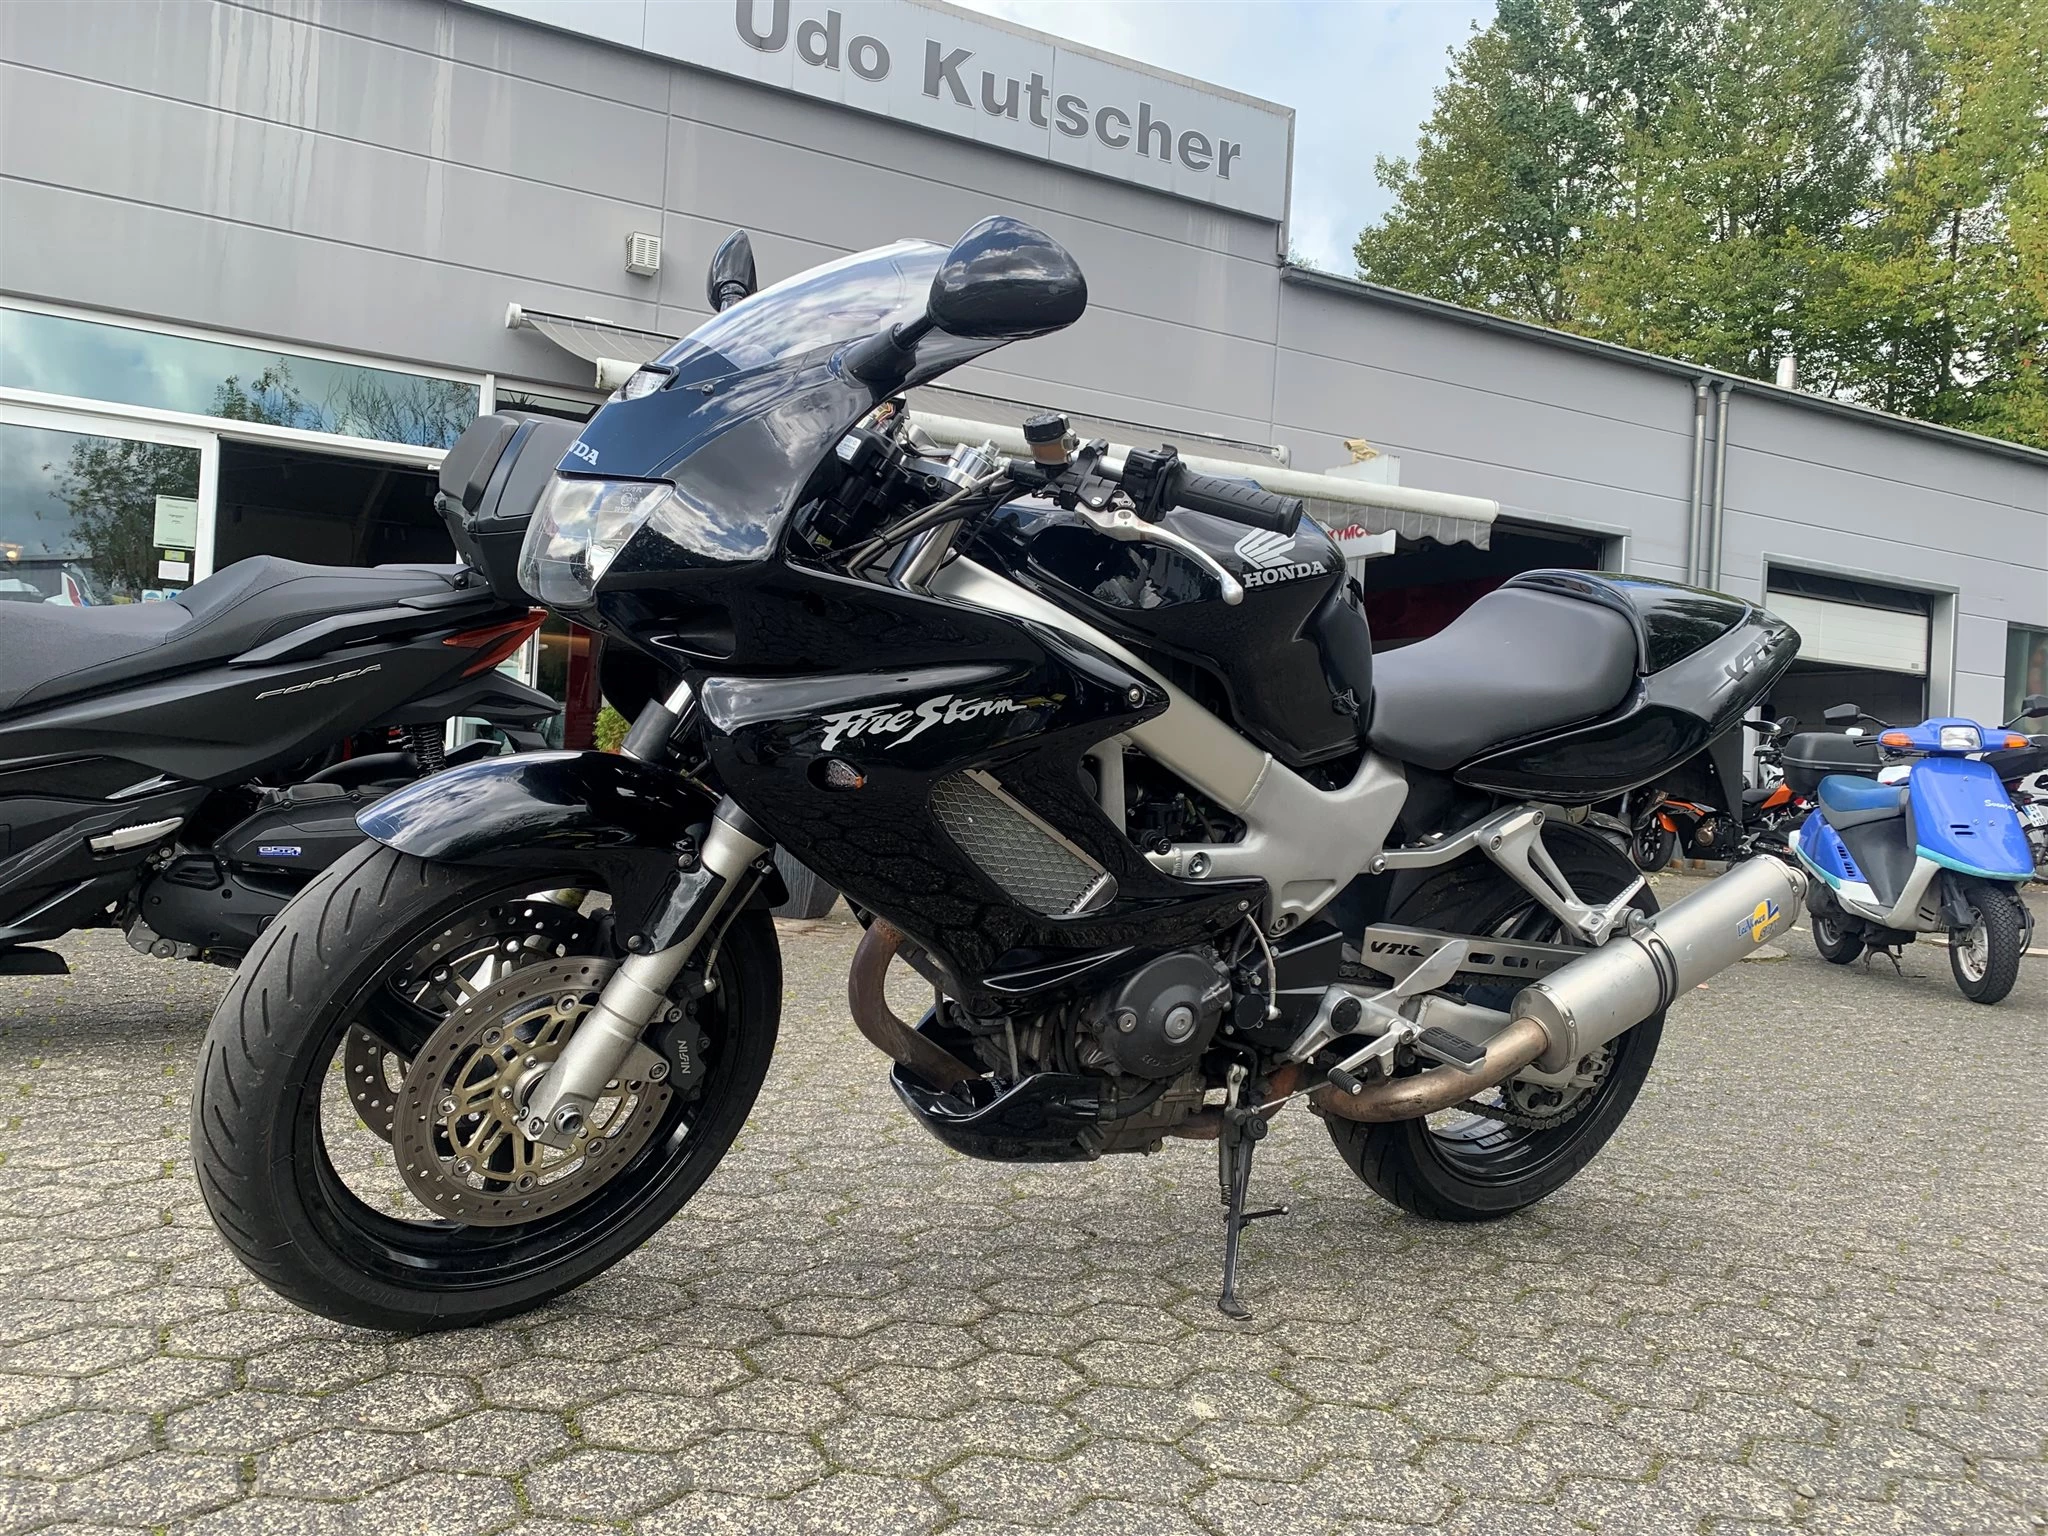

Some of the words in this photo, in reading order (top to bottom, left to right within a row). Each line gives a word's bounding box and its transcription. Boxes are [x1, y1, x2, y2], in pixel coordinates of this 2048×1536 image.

[735, 0, 891, 82] Udo
[922, 38, 1241, 180] Kutscher
[1328, 525, 1371, 542] KYMC
[1243, 560, 1327, 588] HONDA
